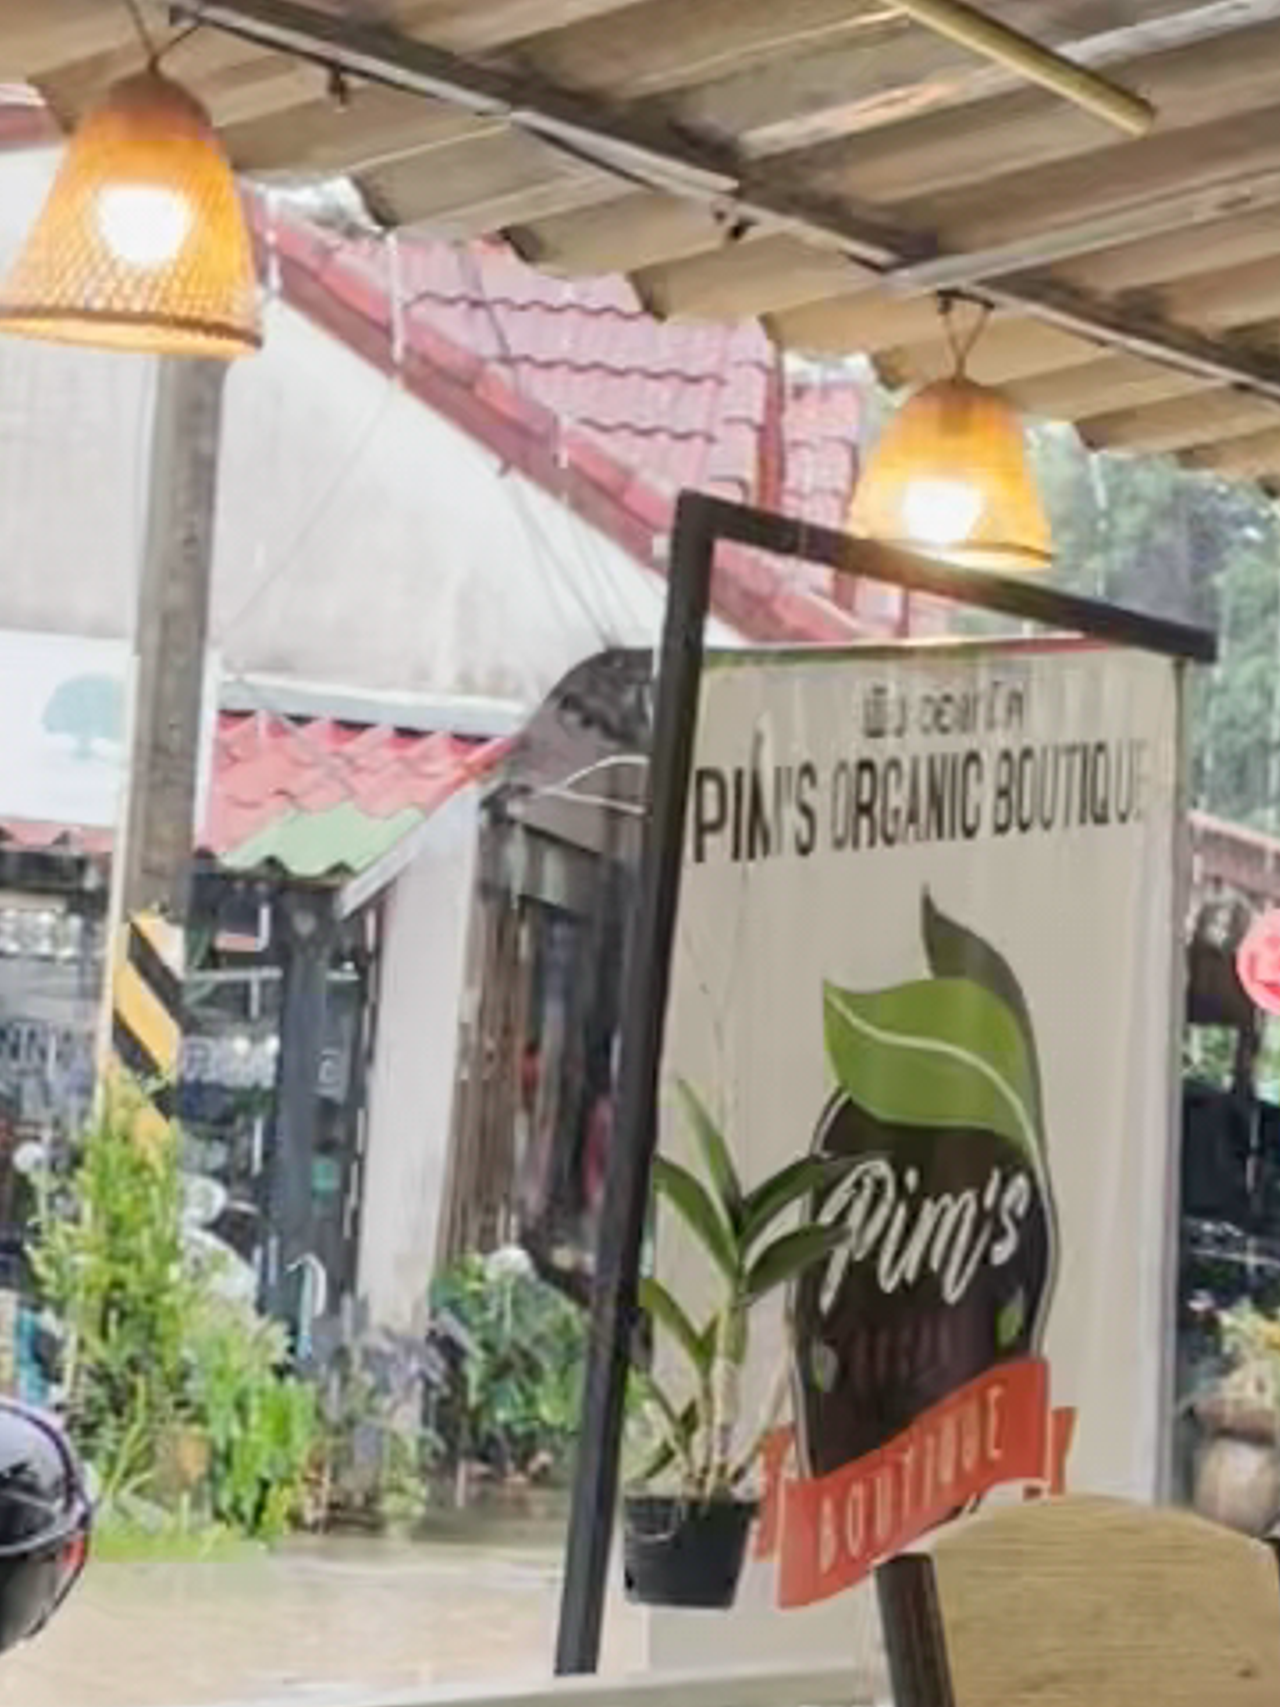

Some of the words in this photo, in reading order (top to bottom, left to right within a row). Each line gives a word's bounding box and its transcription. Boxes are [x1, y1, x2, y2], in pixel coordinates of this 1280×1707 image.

[830, 751, 983, 850] ORGANIC
[819, 1160, 1031, 1314] Pim's
[819, 1387, 1002, 1573] BOUTIQUE
